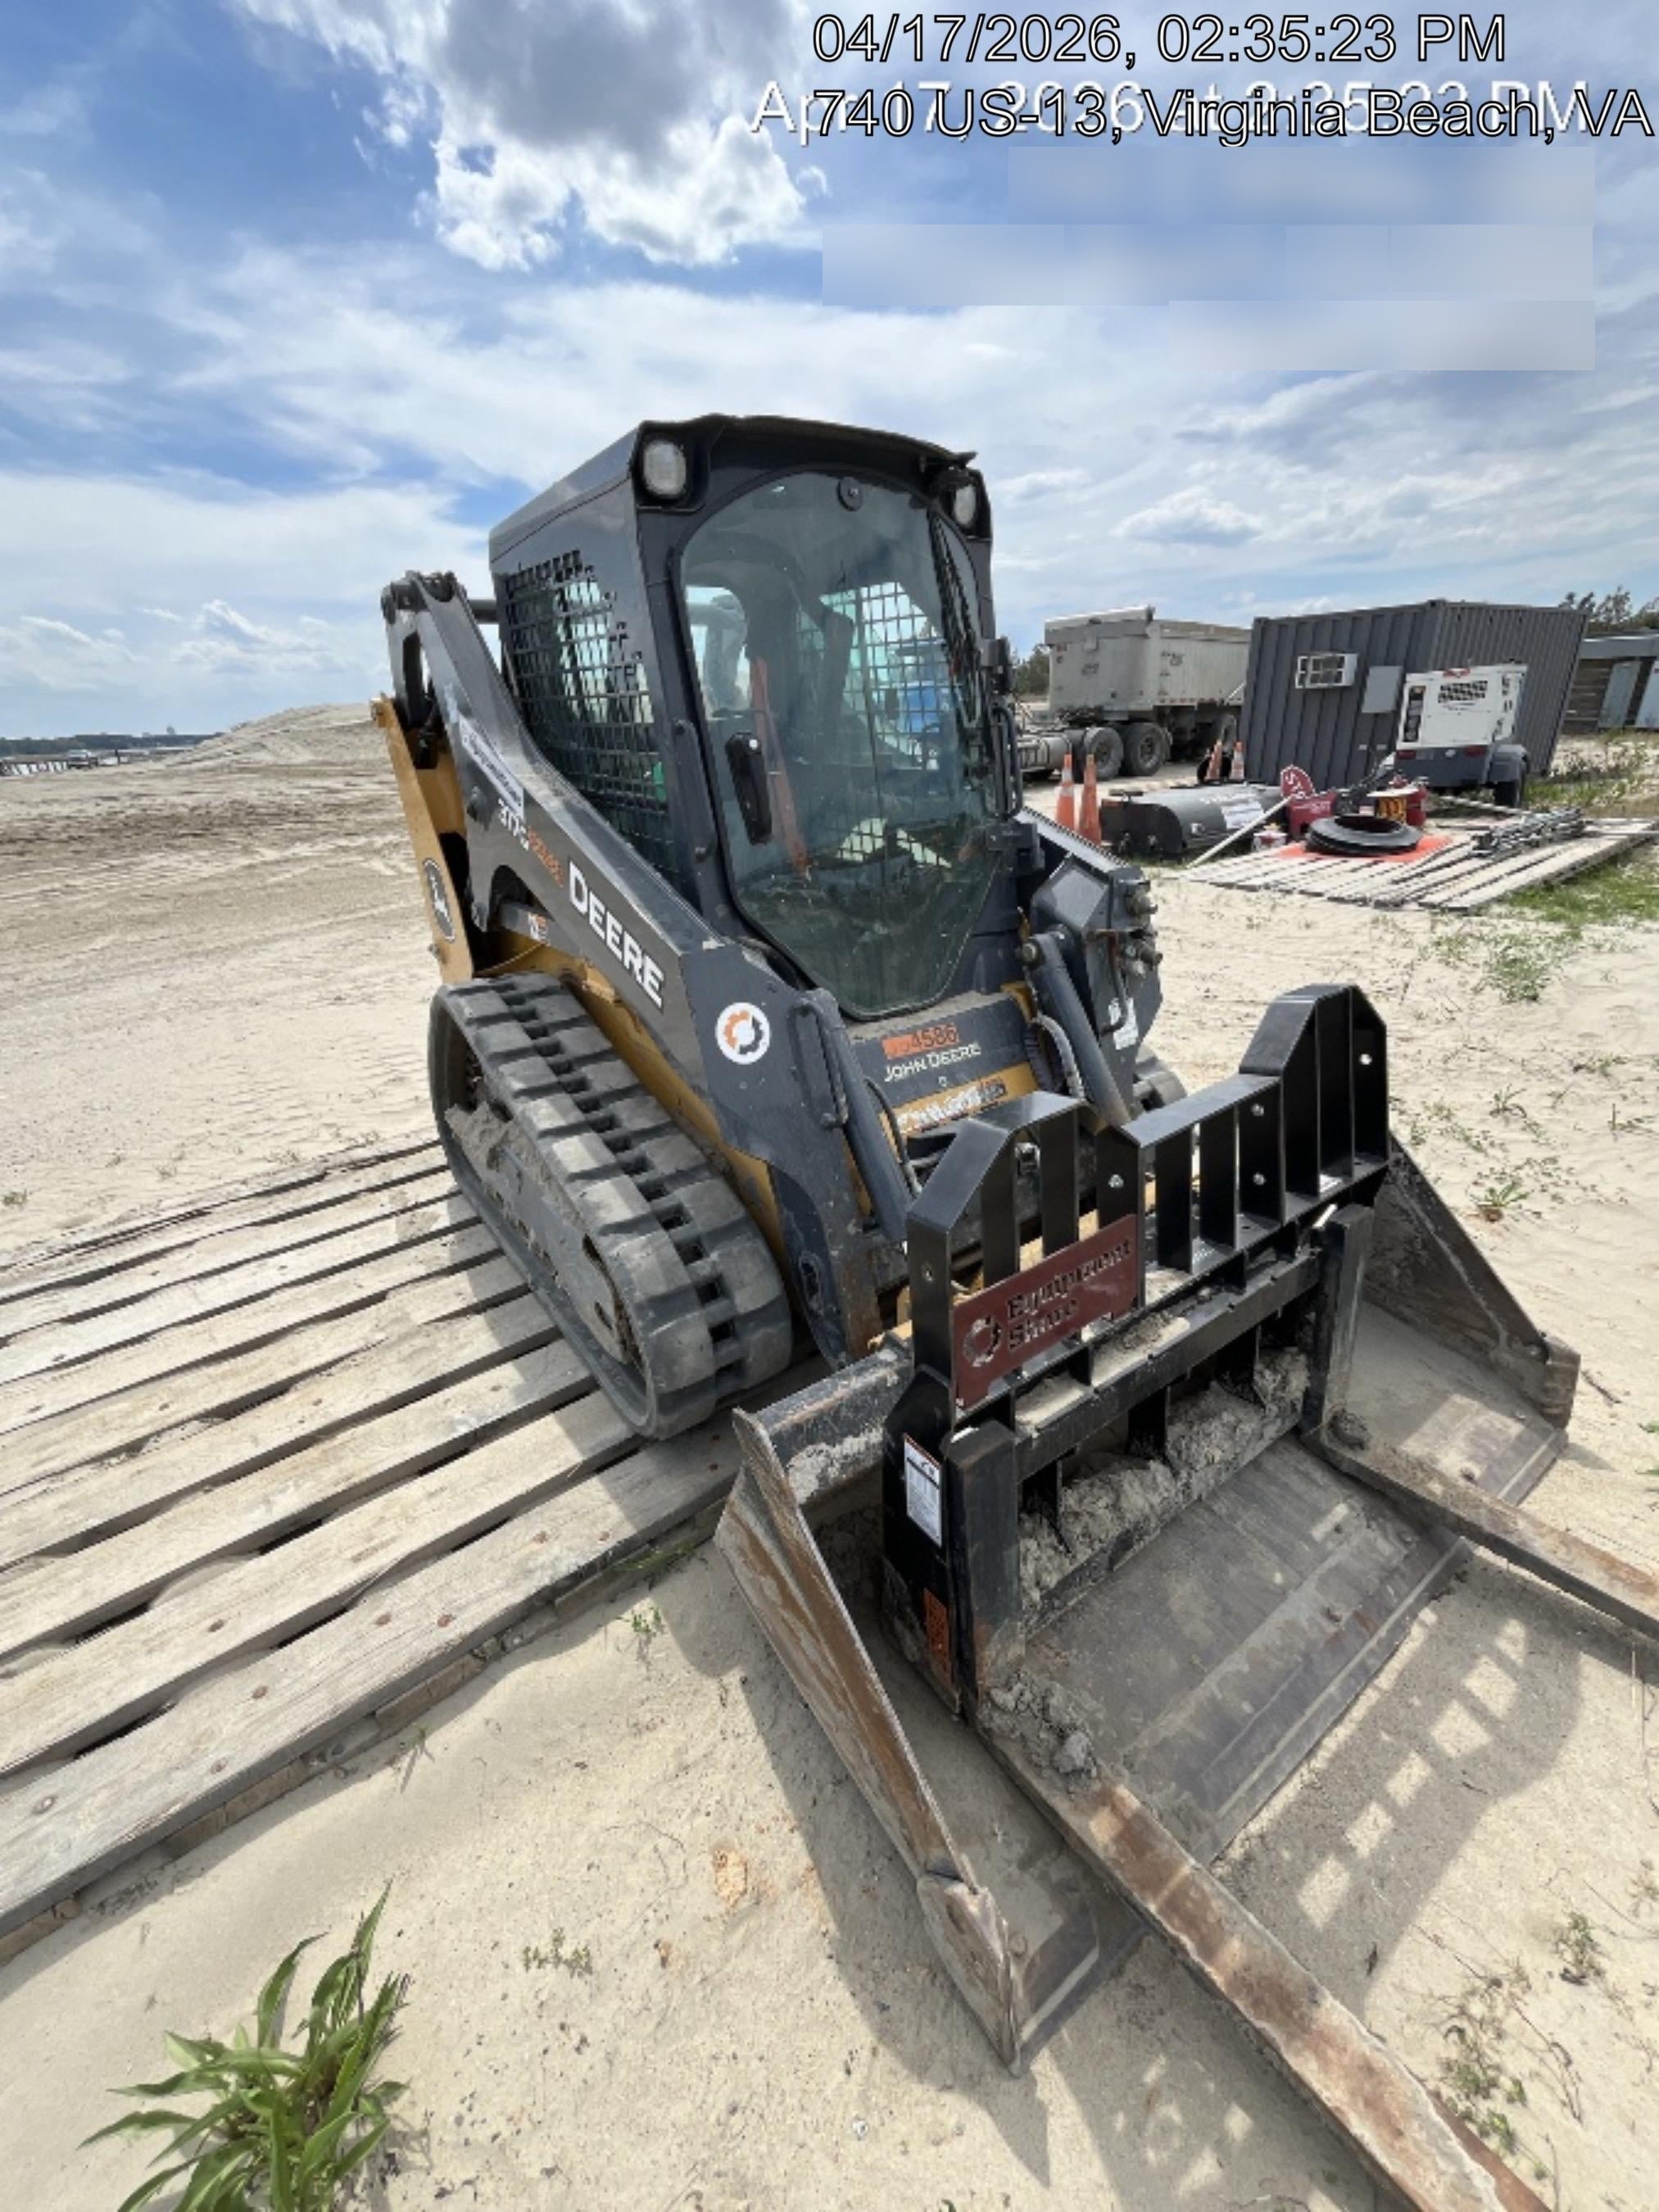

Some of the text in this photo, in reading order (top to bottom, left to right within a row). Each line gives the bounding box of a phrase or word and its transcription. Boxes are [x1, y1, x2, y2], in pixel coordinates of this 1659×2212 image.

[569, 859, 664, 1009] DEERE
[884, 1042, 981, 1083] JOHN DEERE
